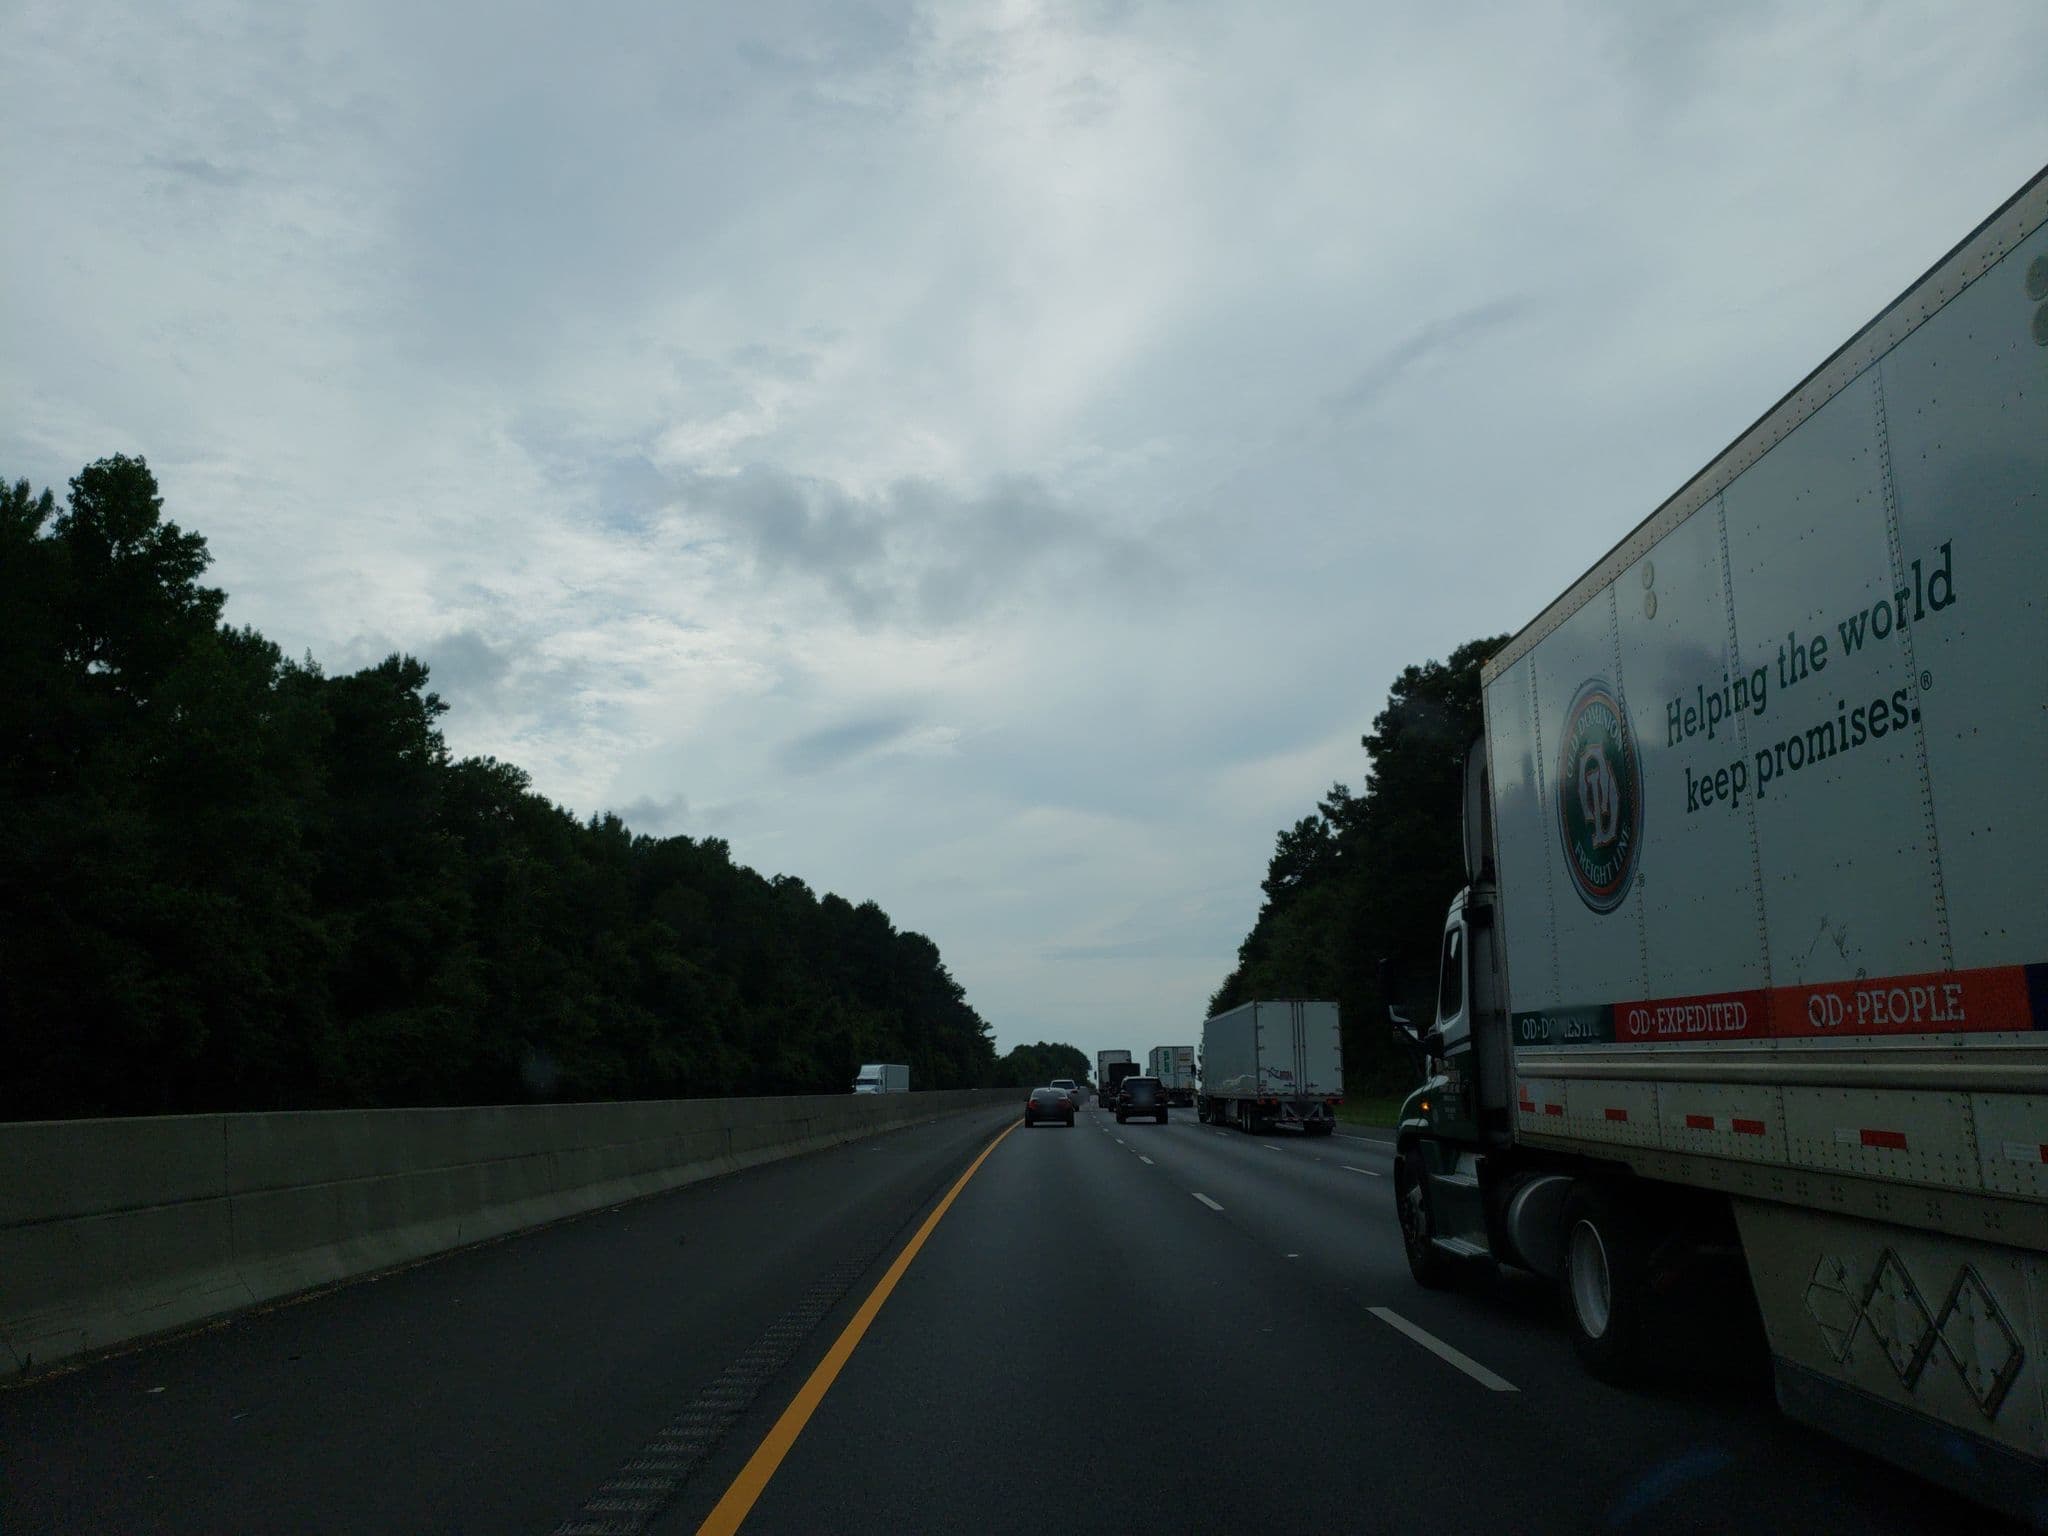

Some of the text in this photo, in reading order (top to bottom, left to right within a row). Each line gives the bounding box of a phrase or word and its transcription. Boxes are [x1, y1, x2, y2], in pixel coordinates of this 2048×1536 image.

[1666, 538, 1957, 748] Helping the world
[1686, 760, 1747, 813] keep
[1574, 840, 1612, 885] FREIGHT
